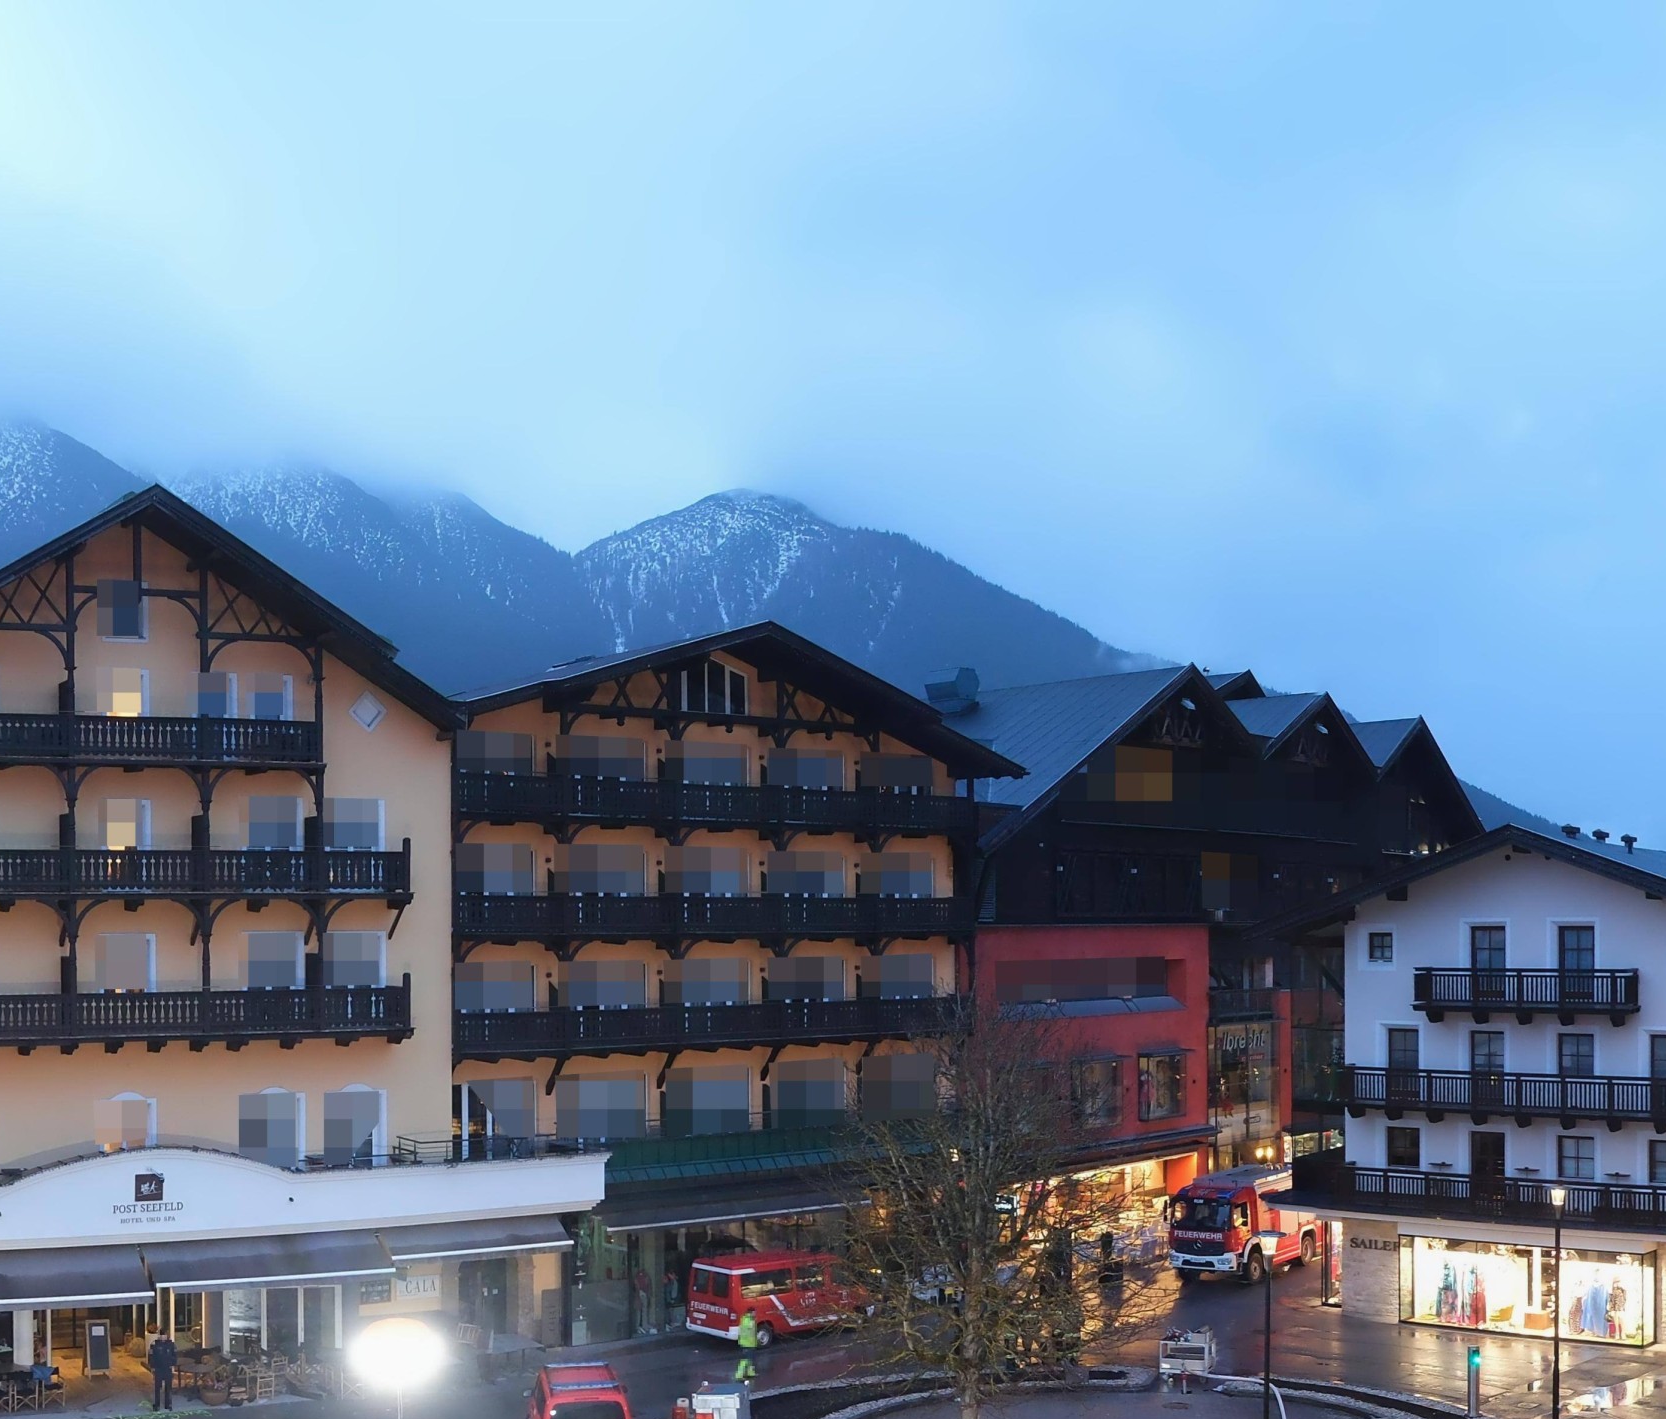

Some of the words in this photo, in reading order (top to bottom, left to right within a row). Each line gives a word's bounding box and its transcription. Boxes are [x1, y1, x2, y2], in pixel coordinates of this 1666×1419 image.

[113, 1204, 139, 1214] POST
[140, 1201, 184, 1213] SEEFELD
[1174, 1230, 1223, 1240] FEUERWEHR
[405, 1279, 436, 1294] CALA
[690, 1301, 729, 1316] FEUERWEHR
